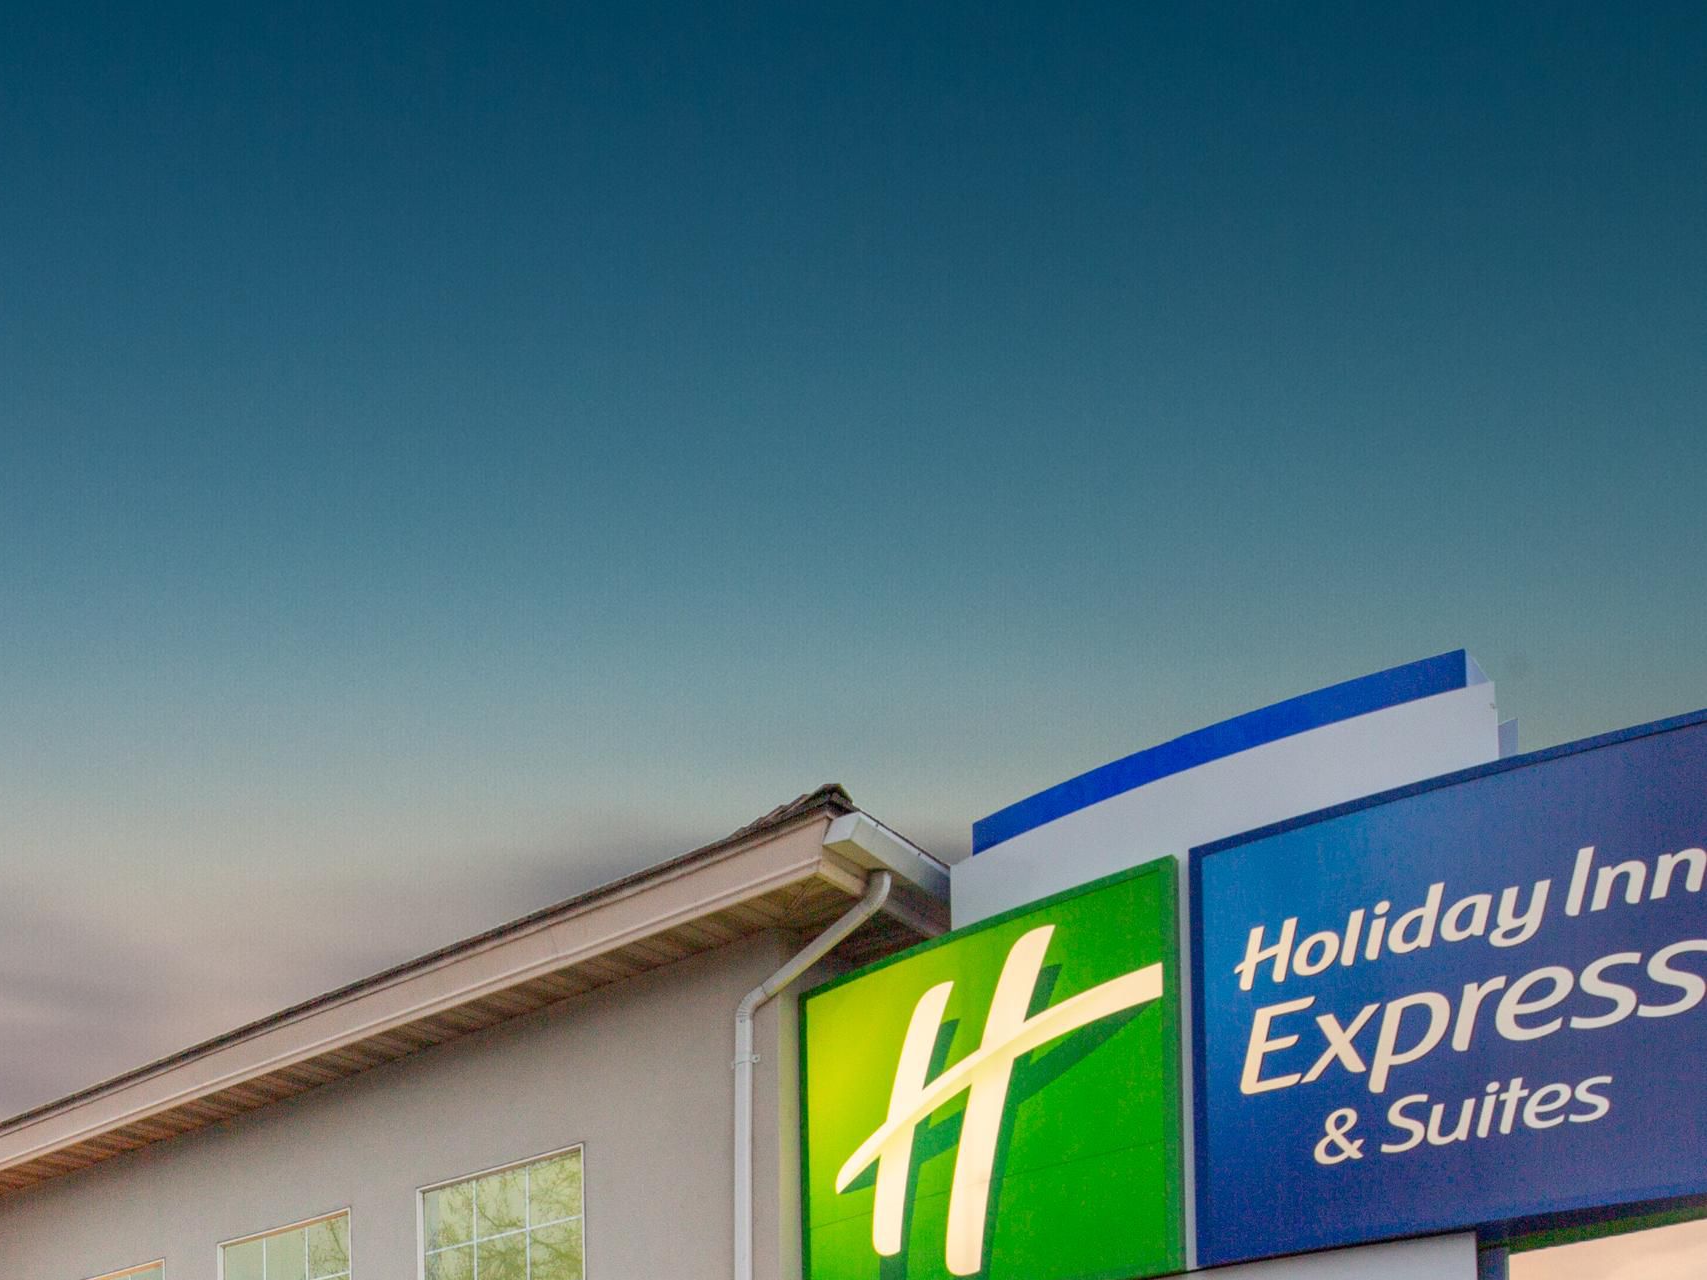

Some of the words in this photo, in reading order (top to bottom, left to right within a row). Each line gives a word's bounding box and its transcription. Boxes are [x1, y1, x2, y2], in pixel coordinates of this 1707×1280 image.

[1234, 880, 1551, 991] Holiday
[1564, 845, 1707, 917] Inn
[1239, 939, 1707, 1095] Express
[1313, 1107, 1364, 1165] &
[1380, 1076, 1613, 1153] Suites
